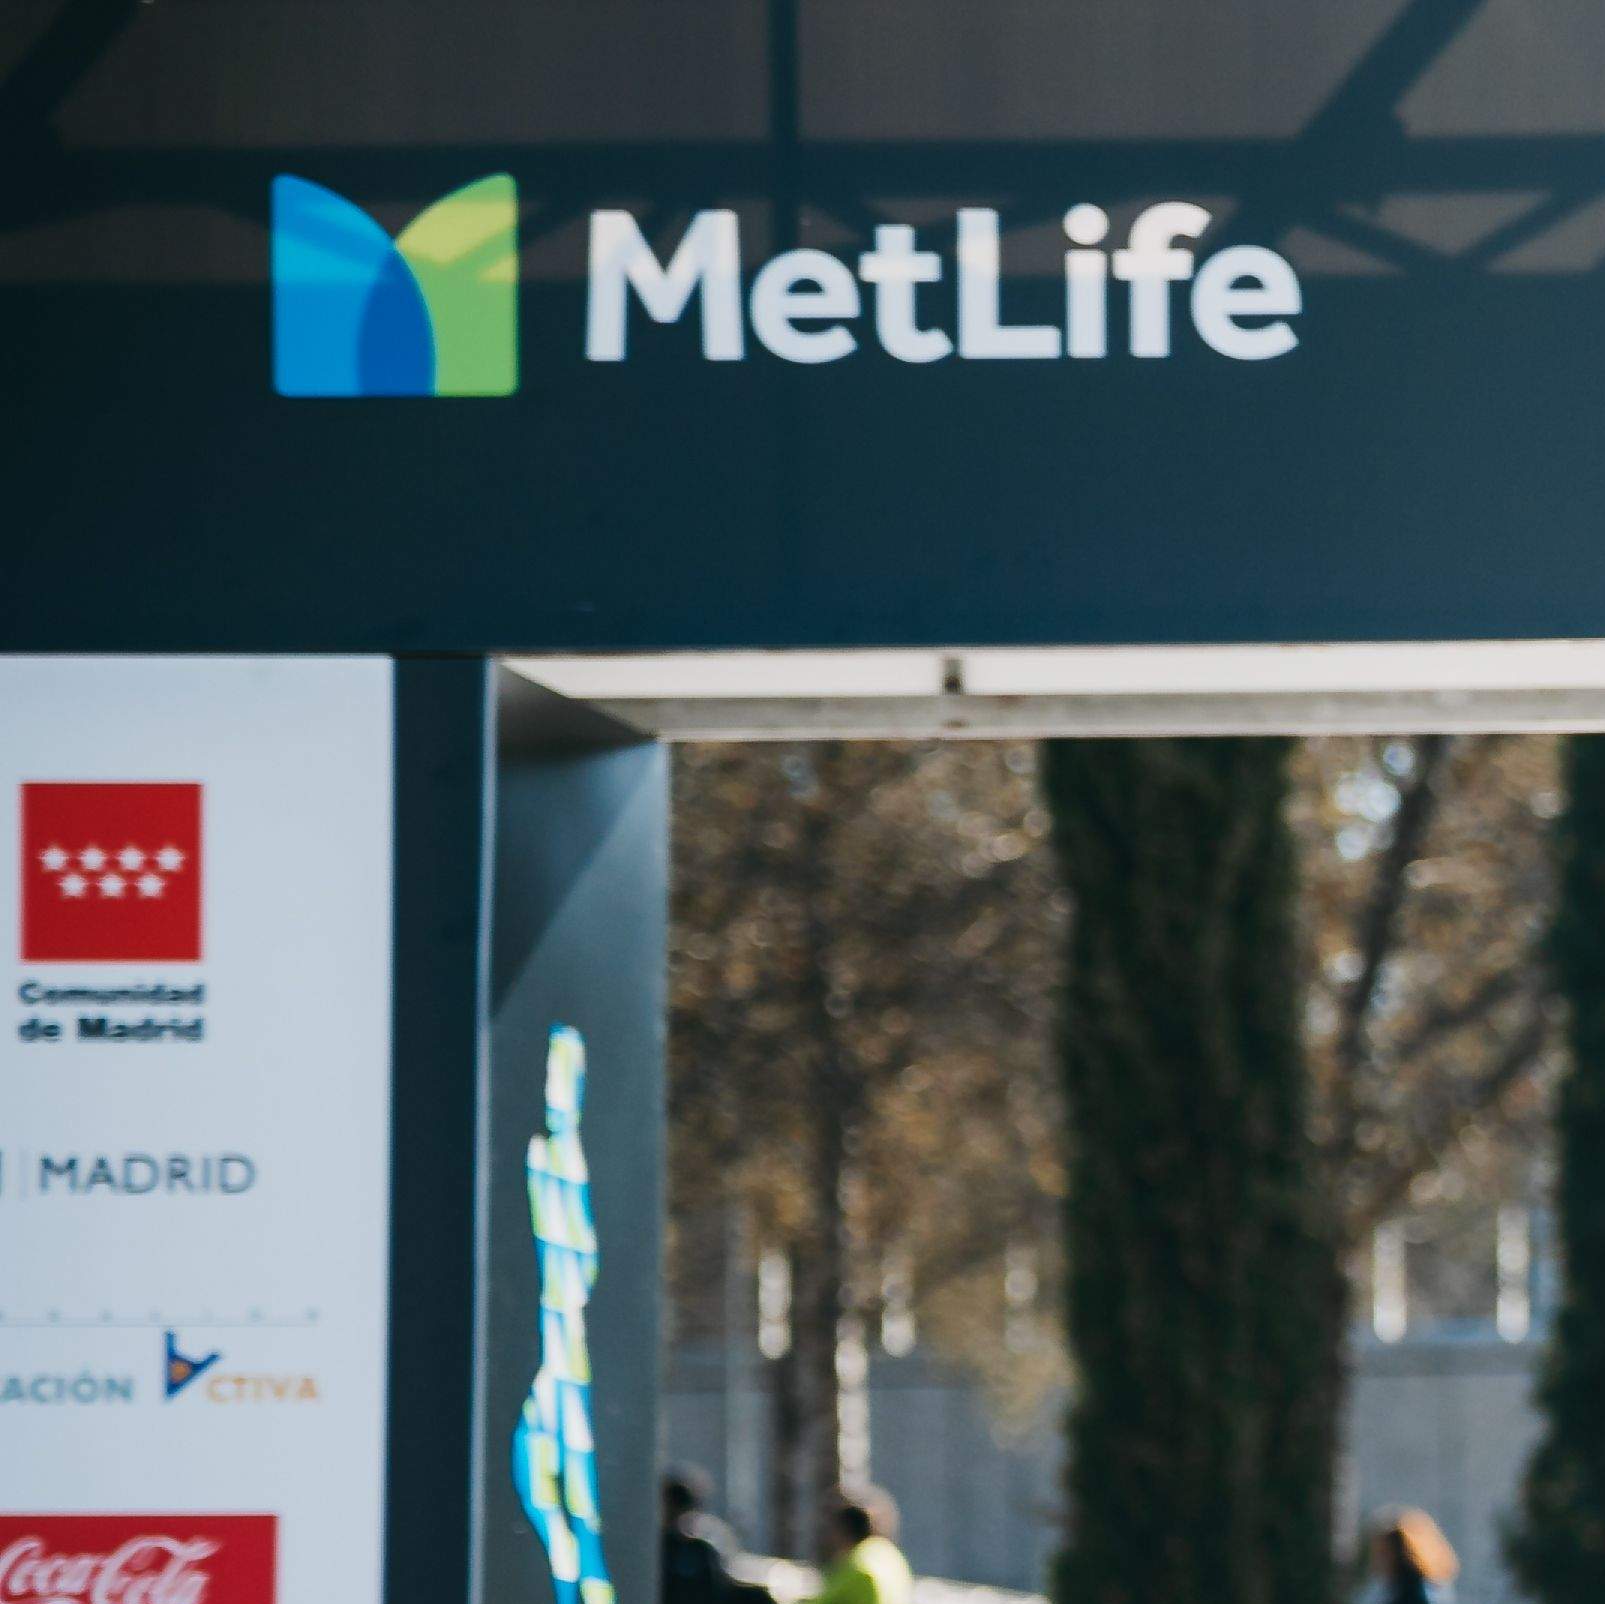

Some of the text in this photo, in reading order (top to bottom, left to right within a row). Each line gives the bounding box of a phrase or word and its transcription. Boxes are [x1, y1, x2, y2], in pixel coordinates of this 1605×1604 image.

[584, 201, 1303, 365] MetLife
[17, 1015, 206, 1042] de Madrid
[40, 1154, 257, 1196] MADRID
